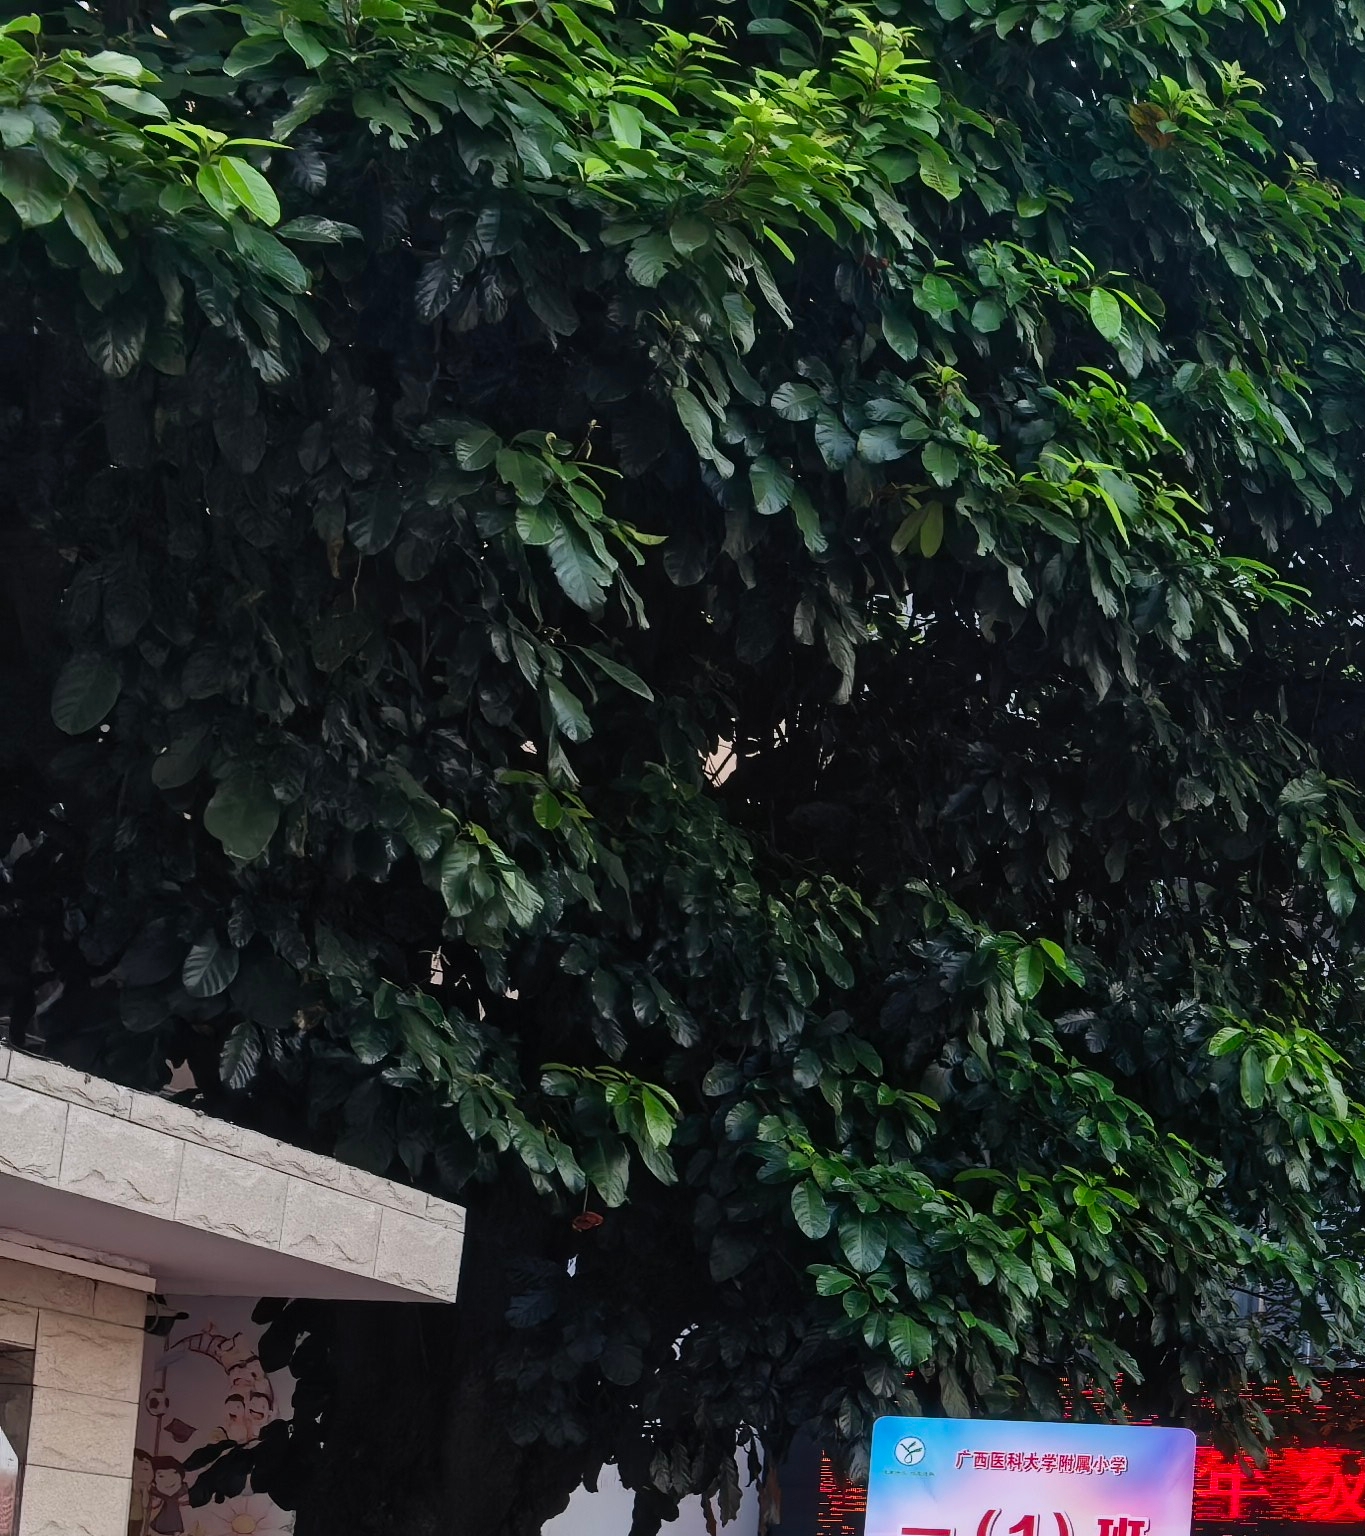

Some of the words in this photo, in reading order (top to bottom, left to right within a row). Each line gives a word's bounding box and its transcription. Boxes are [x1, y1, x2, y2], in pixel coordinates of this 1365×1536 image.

[955, 1450, 1128, 1475] 广西医科大学附属小学
